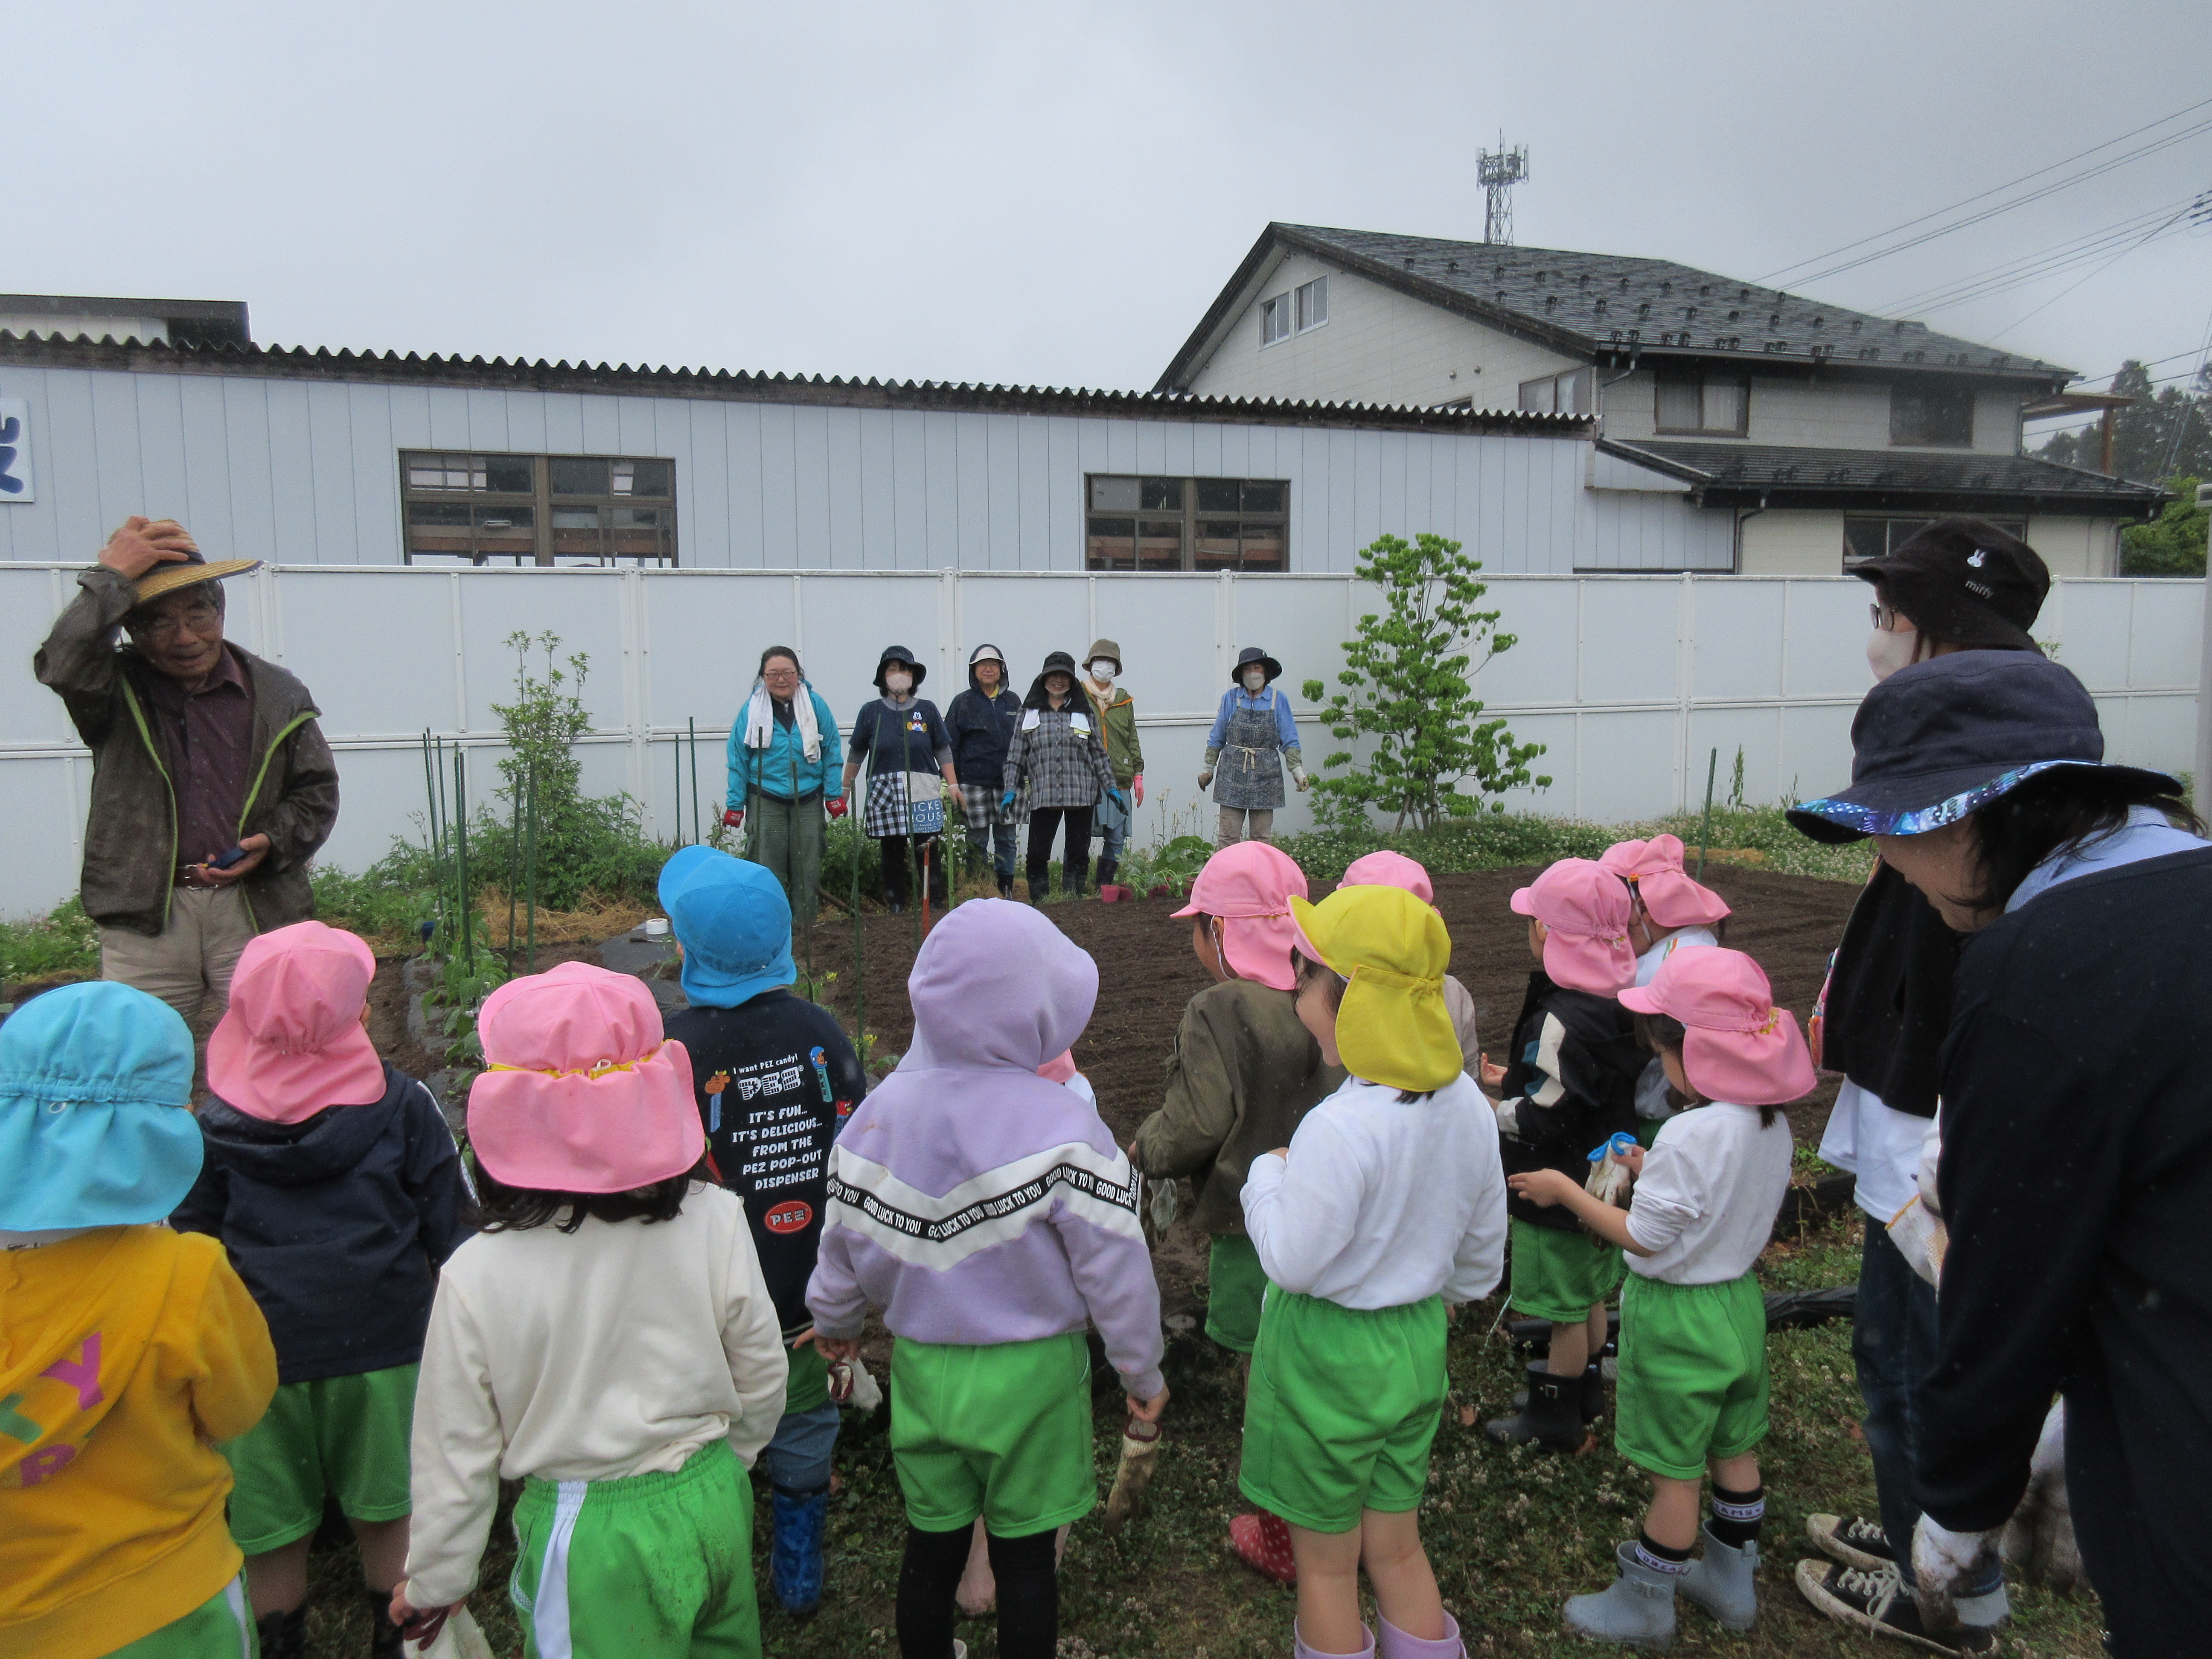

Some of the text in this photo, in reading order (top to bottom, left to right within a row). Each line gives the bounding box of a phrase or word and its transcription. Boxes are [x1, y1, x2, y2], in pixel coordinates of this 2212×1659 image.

[1965, 580, 1994, 599] miffy
[739, 1064, 758, 1074] want
[760, 1060, 774, 1070] PEZ
[776, 1053, 798, 1066] candy!
[749, 1104, 808, 1123] IT'S FUN...
[732, 1129, 757, 1143] IT'S
[761, 1117, 822, 1139] DELICIOUS...
[752, 1135, 812, 1157] FROM THE
[742, 1149, 822, 1175] PEZ POP-OUT
[755, 1167, 819, 1190] DISPENSER
[1096, 1181, 1116, 1199] GOOD
[843, 1187, 860, 1203] YOU
[863, 1196, 879, 1216] GOOD
[876, 1205, 894, 1225] LUCK
[895, 1213, 904, 1228] TO
[905, 1217, 922, 1234] YOU
[938, 1217, 962, 1237] LUCK
[958, 1213, 971, 1227] TO
[967, 1205, 985, 1221] YOU
[994, 1195, 1016, 1214] LUCK
[1012, 1190, 1026, 1205] TO
[1023, 1182, 1042, 1200] YOU
[1046, 1167, 1062, 1187] GOOD
[1078, 1172, 1088, 1187] TO
[770, 1209, 805, 1226] PEZ
